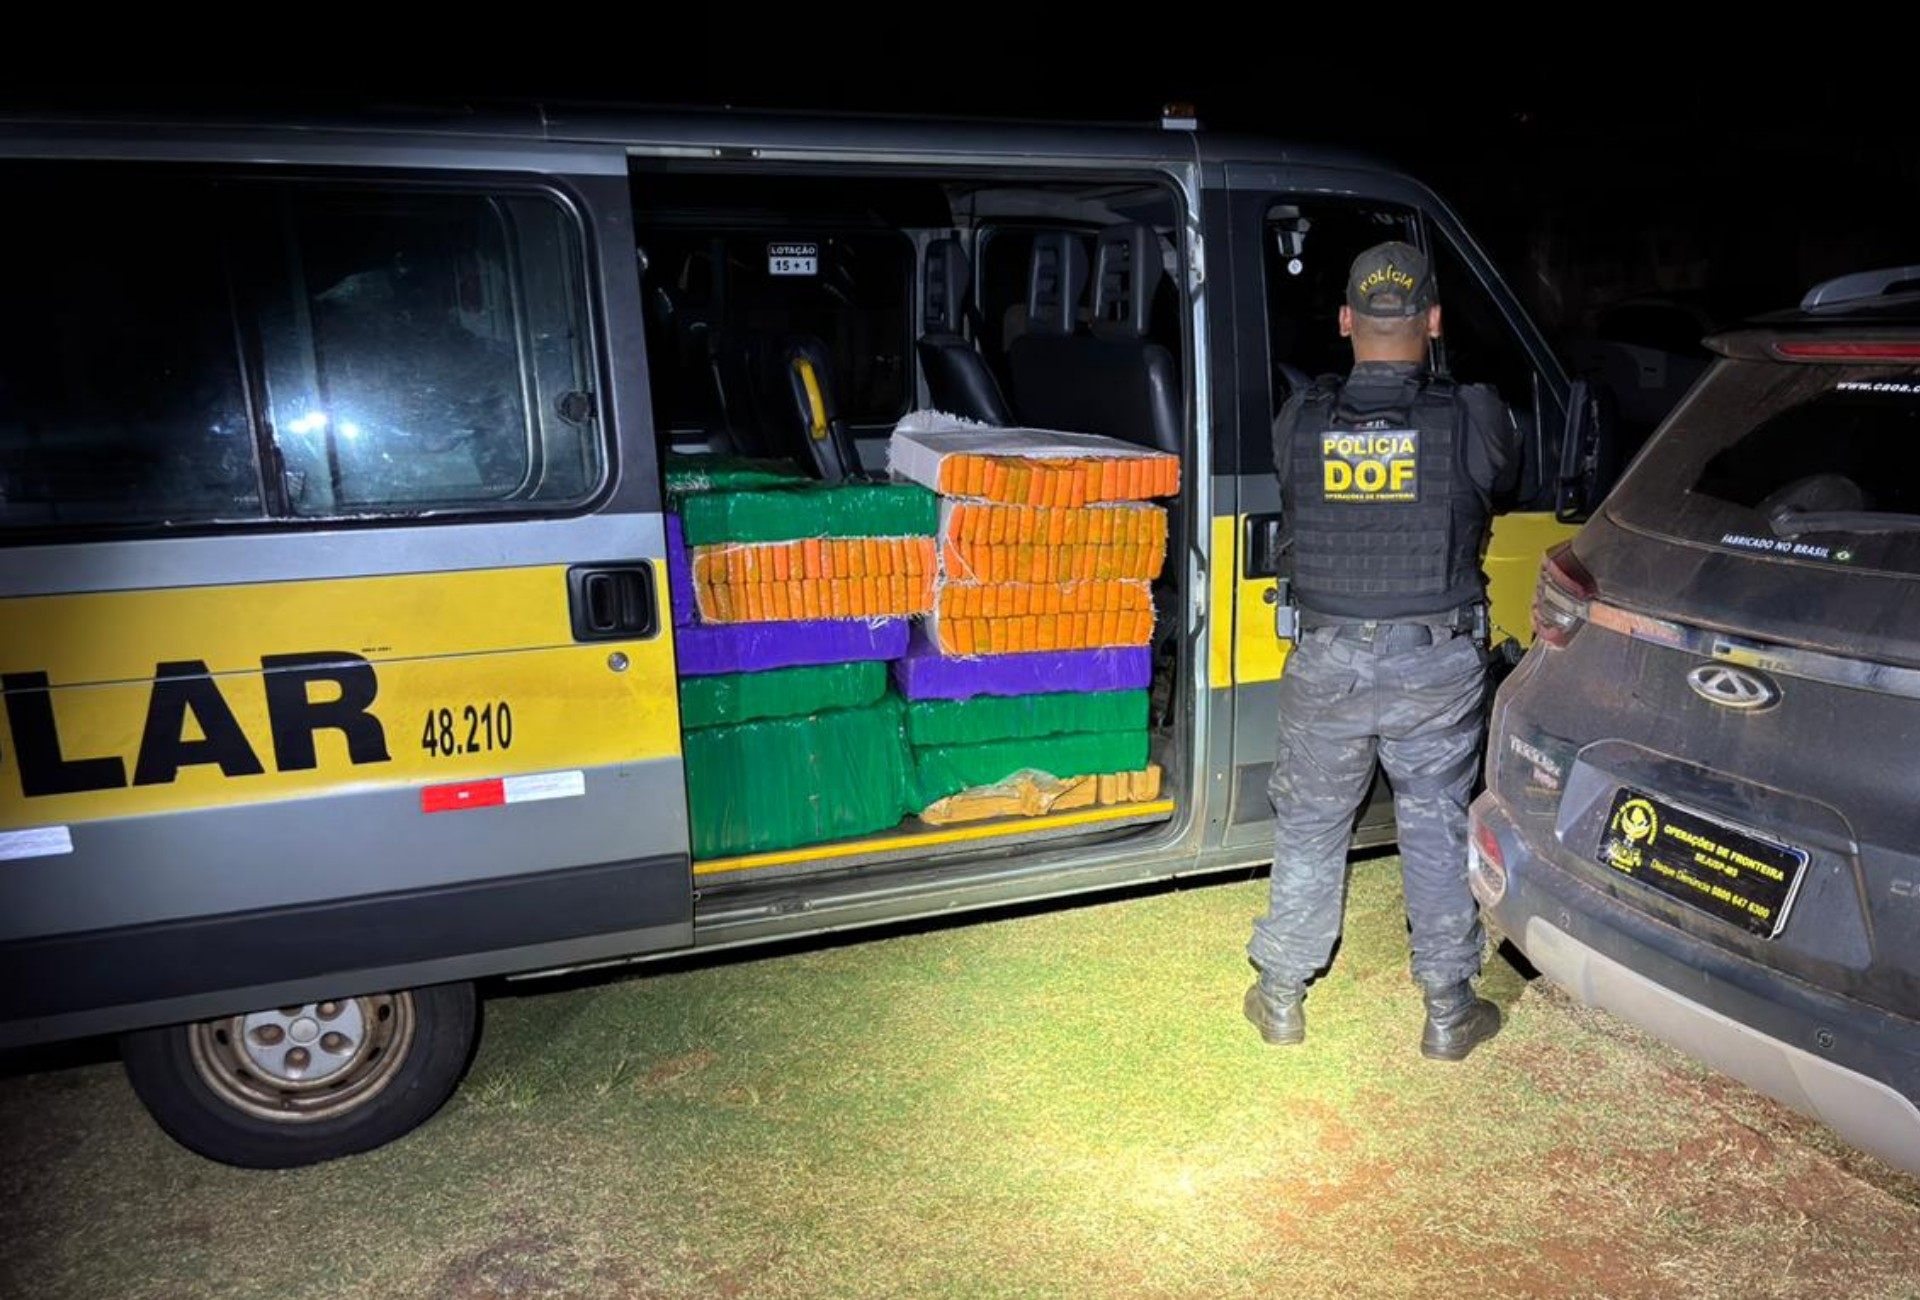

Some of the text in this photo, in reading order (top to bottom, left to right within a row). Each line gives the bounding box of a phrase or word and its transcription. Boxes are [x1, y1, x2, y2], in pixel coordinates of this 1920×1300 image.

[771, 246, 815, 256] LOTAÇÃO
[775, 260, 790, 271] 15
[805, 260, 811, 271] 1
[1323, 435, 1416, 456] POLÍCIA
[1324, 460, 1416, 493] DOF
[1721, 534, 1829, 558] FABRICADO NO BRASIL
[0, 650, 392, 798] LAR
[422, 701, 512, 757] 48.210
[1716, 845, 1731, 858] DE
[1730, 851, 1784, 881] FRONTEIRA
